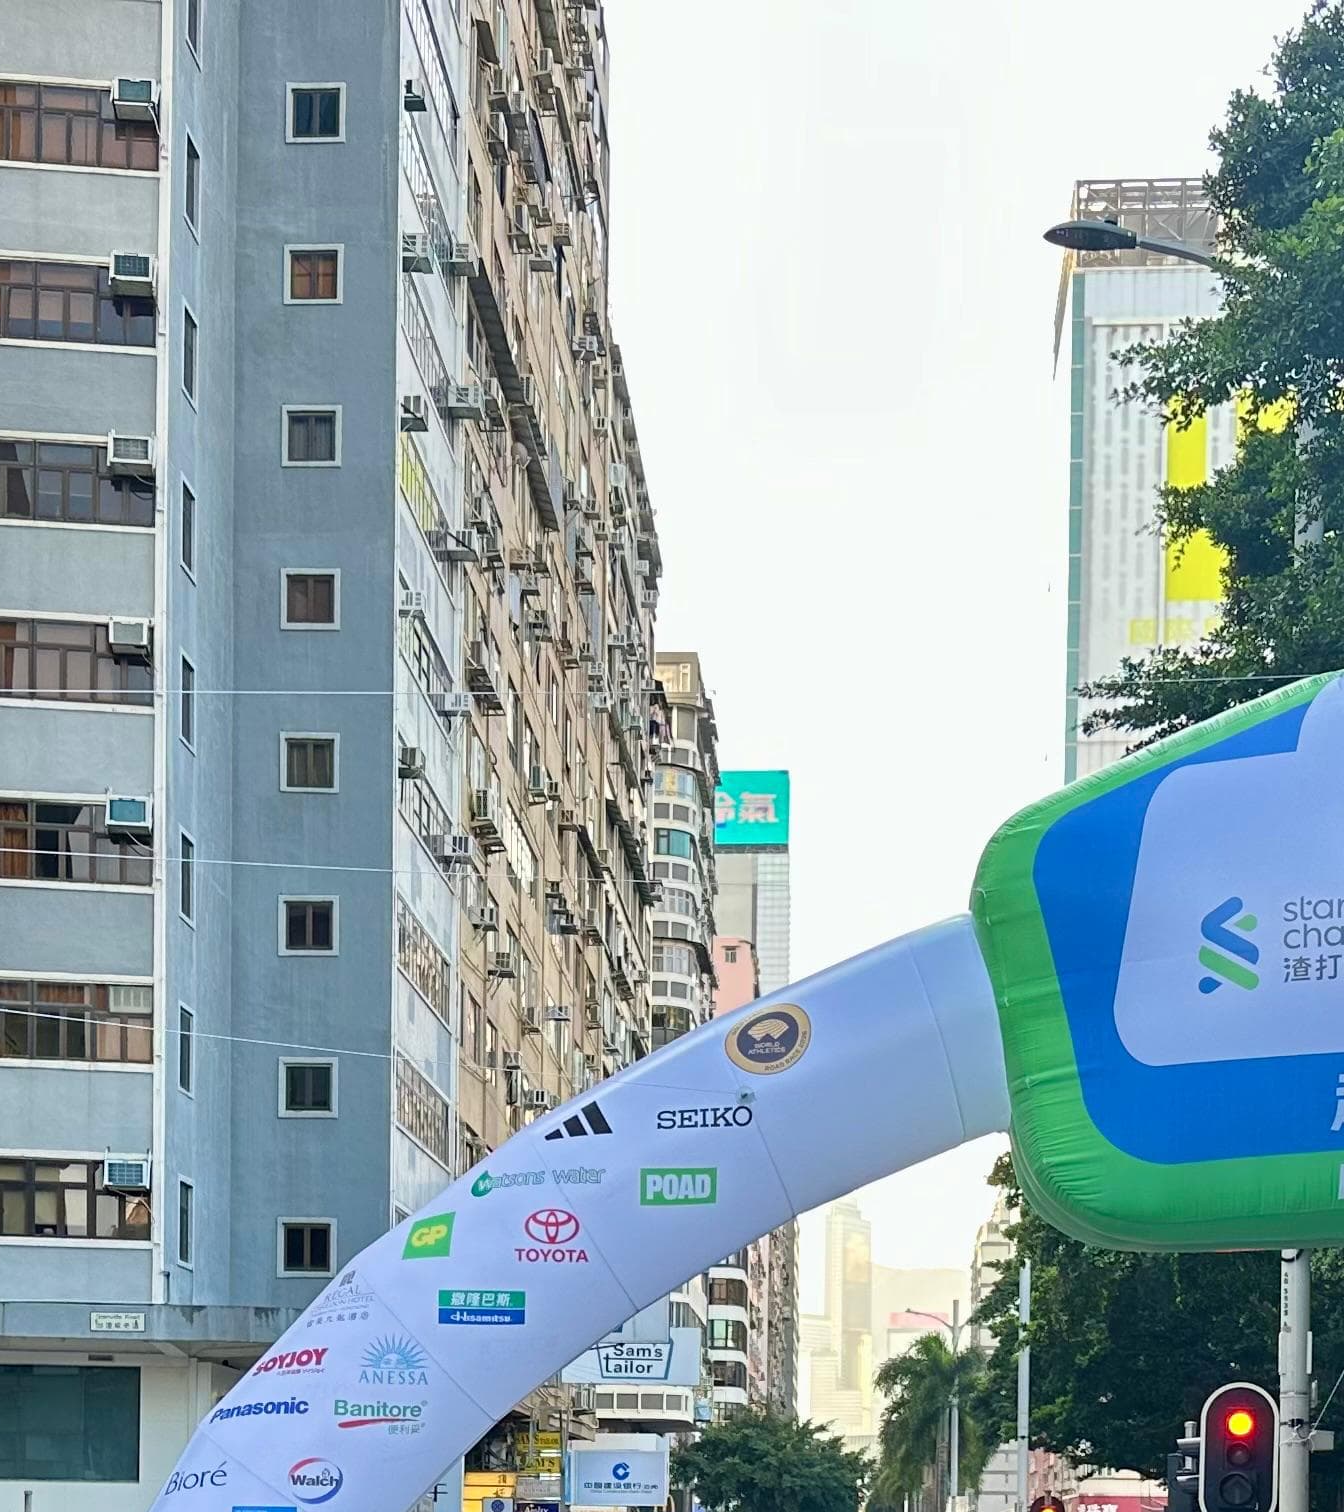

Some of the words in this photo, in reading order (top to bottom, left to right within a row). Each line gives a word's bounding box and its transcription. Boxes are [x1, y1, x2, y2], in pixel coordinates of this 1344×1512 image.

[657, 1105, 753, 1130] SEIKO
[552, 1166, 606, 1185] water
[645, 1173, 712, 1201] POAD
[409, 1224, 449, 1248] GP
[514, 1248, 589, 1263] TOYOTA
[252, 1347, 329, 1377] SOYJOY
[604, 1352, 654, 1374] tailor
[359, 1370, 429, 1386] ANESSA
[209, 1396, 310, 1425] Panasonic
[164, 1461, 228, 1496] Bioré
[290, 1471, 340, 1488] Walch
